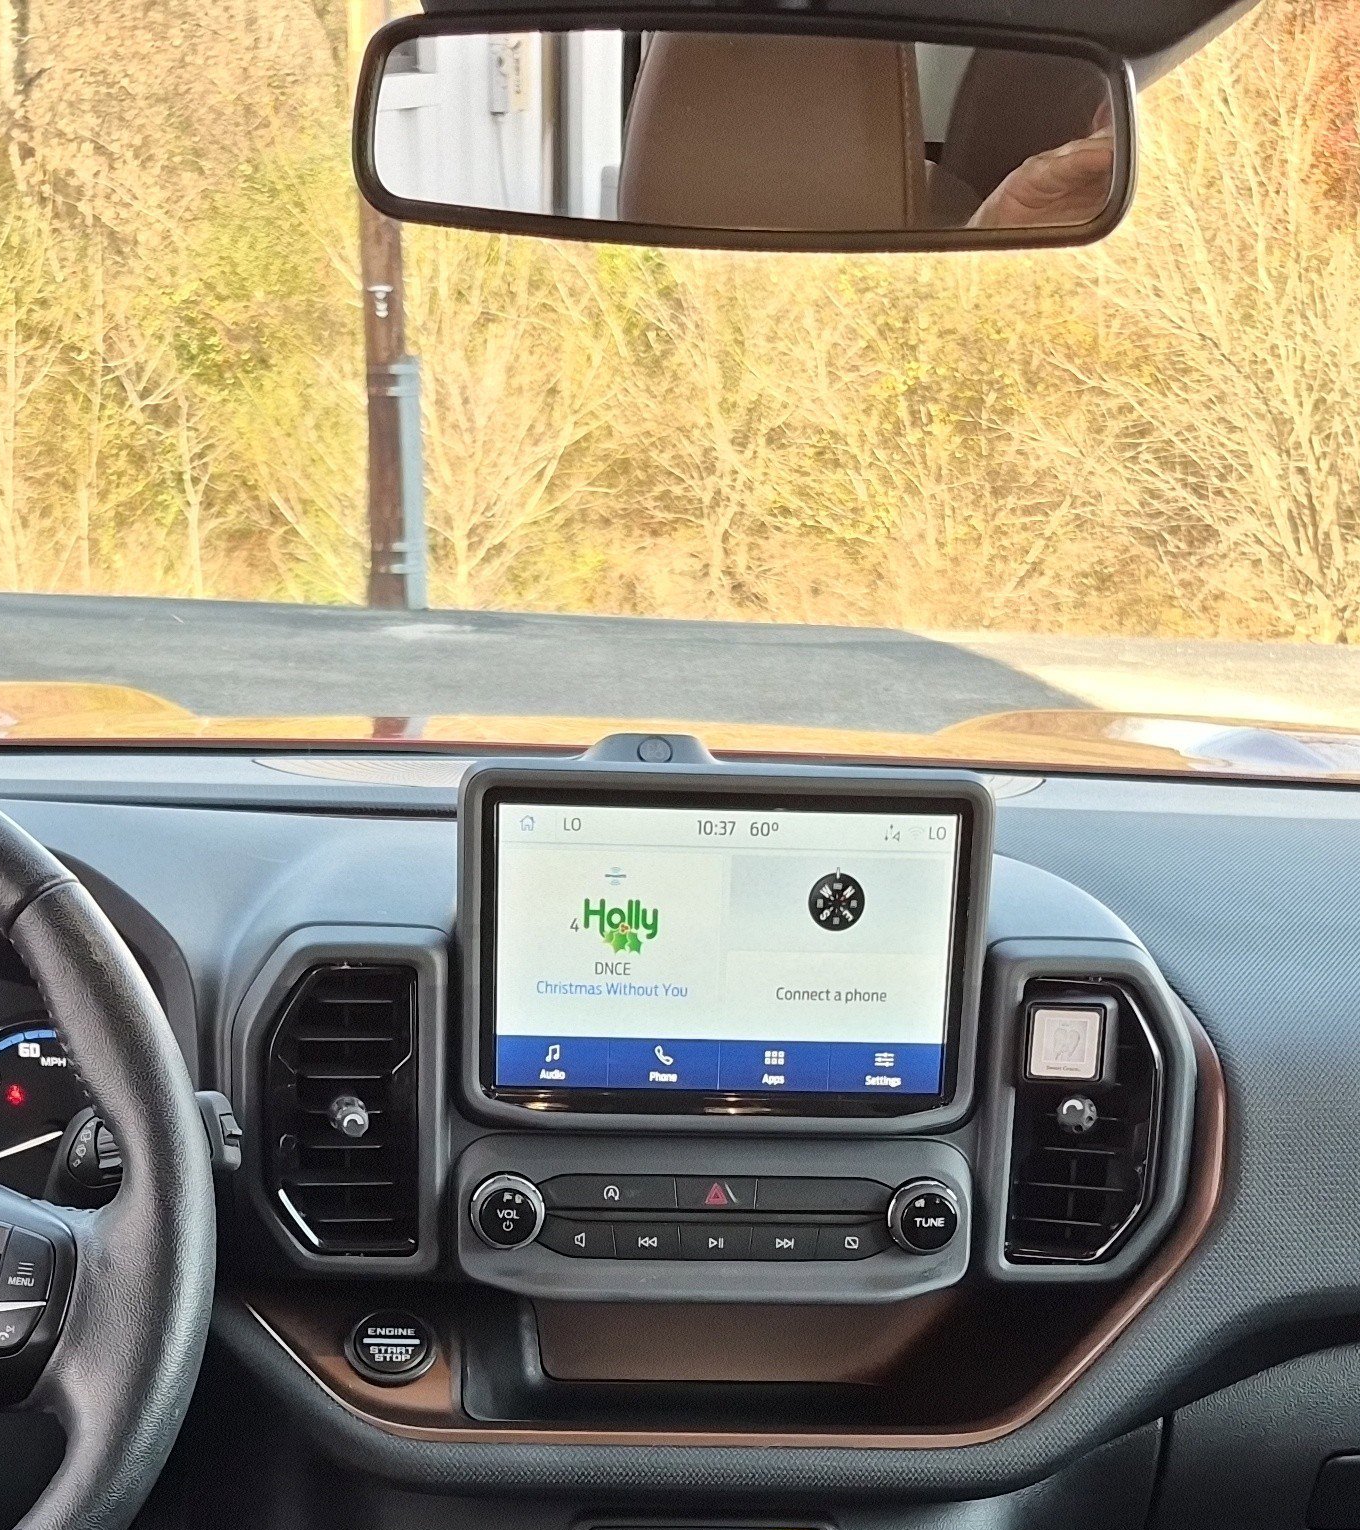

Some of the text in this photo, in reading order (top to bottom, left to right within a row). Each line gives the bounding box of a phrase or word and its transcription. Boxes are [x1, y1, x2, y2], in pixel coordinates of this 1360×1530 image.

[564, 818, 582, 831] LO
[697, 820, 736, 836] 10:37
[929, 826, 947, 840] LO
[583, 898, 659, 940] Holly
[594, 962, 631, 976] DNCE
[536, 980, 688, 998] Christmas Without You
[776, 987, 887, 1004] Connect a phone
[18, 1043, 40, 1058] 60
[41, 1057, 66, 1067] MPH
[540, 1069, 566, 1080] Audio
[649, 1071, 678, 1083] Phone
[762, 1074, 785, 1085] Apps
[865, 1075, 902, 1088] Settings
[496, 1209, 520, 1220] VOL
[914, 1217, 945, 1228] TUNE
[8, 1276, 35, 1287] MENU
[367, 1327, 416, 1336] ENGINE
[369, 1346, 415, 1355] START
[374, 1353, 411, 1362] STOP
